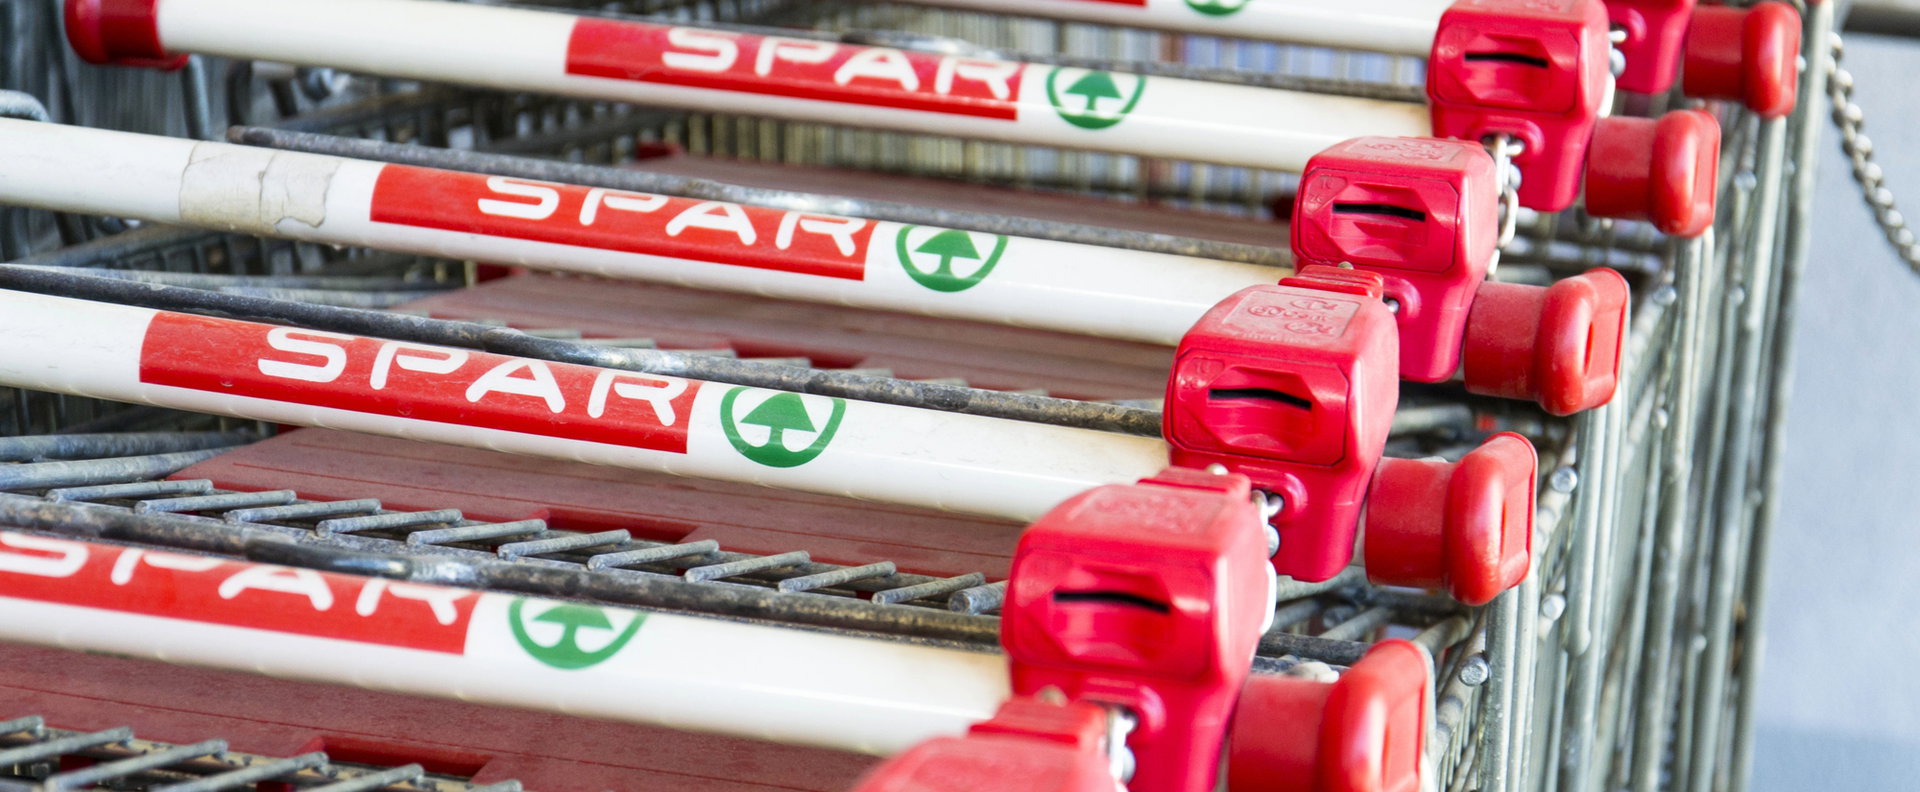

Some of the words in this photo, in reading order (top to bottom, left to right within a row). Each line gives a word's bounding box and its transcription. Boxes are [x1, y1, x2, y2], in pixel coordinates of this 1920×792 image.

[662, 27, 1020, 99] SPAR
[477, 176, 866, 256] SPAR
[258, 327, 689, 426] SPAR
